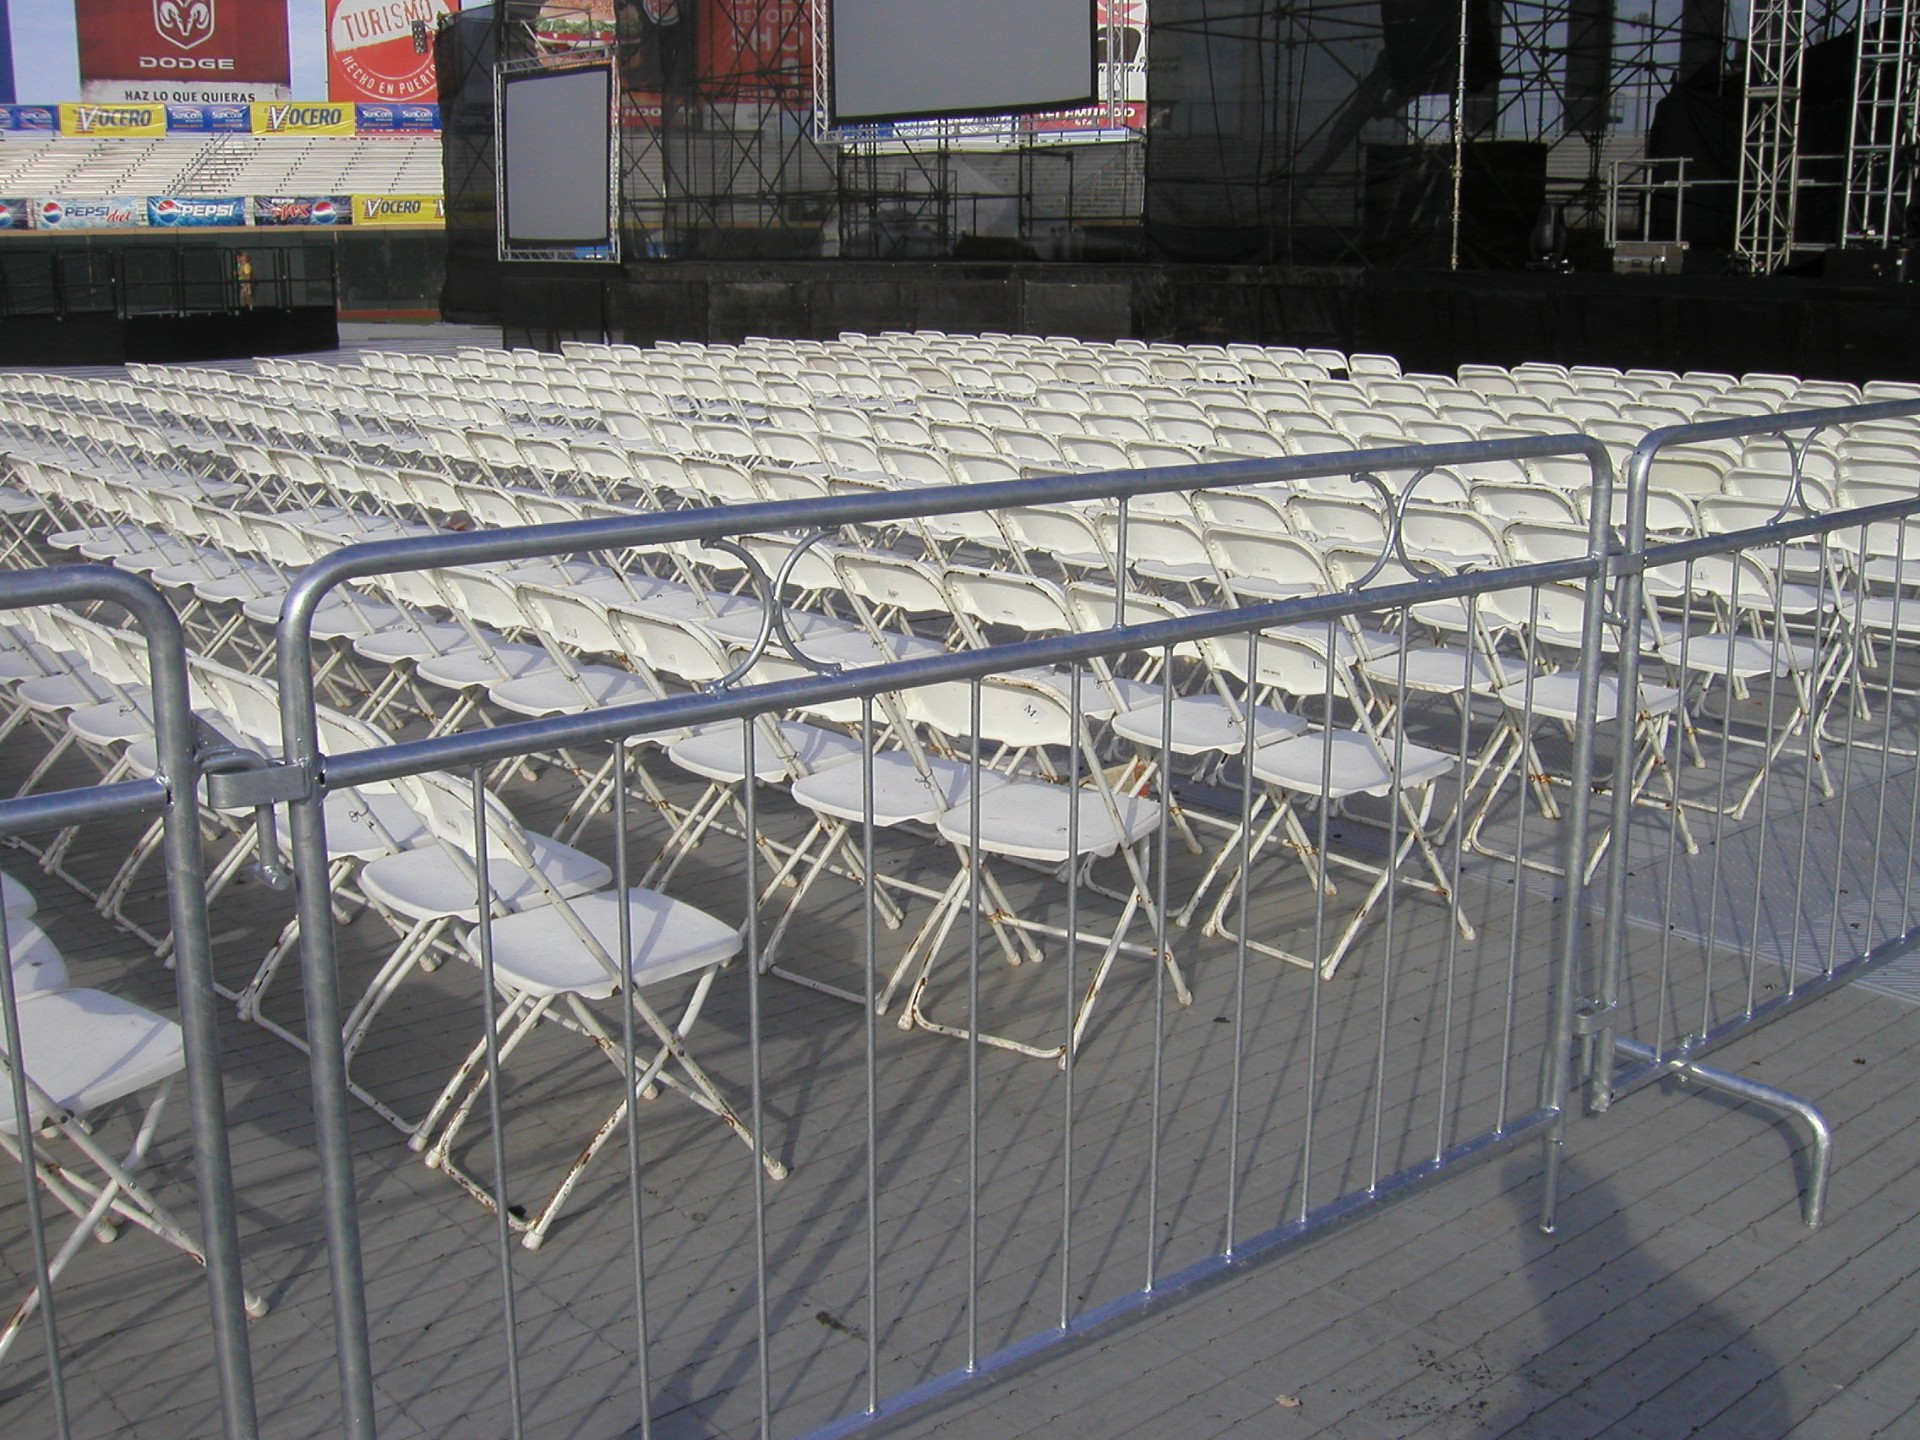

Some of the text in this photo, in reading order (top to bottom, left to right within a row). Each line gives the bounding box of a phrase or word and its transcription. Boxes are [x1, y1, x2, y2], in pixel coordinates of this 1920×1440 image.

[341, 0, 433, 42] TURISMO
[139, 56, 235, 70] DODGE
[342, 56, 375, 89] HECHO
[379, 82, 394, 94] EN
[125, 90, 256, 103] HAZ LO QUE QUIERAS
[78, 106, 151, 131] VOCERO
[270, 105, 342, 130] VOCERO
[65, 206, 131, 222] PEPSI diet
[182, 204, 234, 217] PEPSI
[363, 199, 422, 218] VOCERO
[1543, 611, 1551, 620] K
